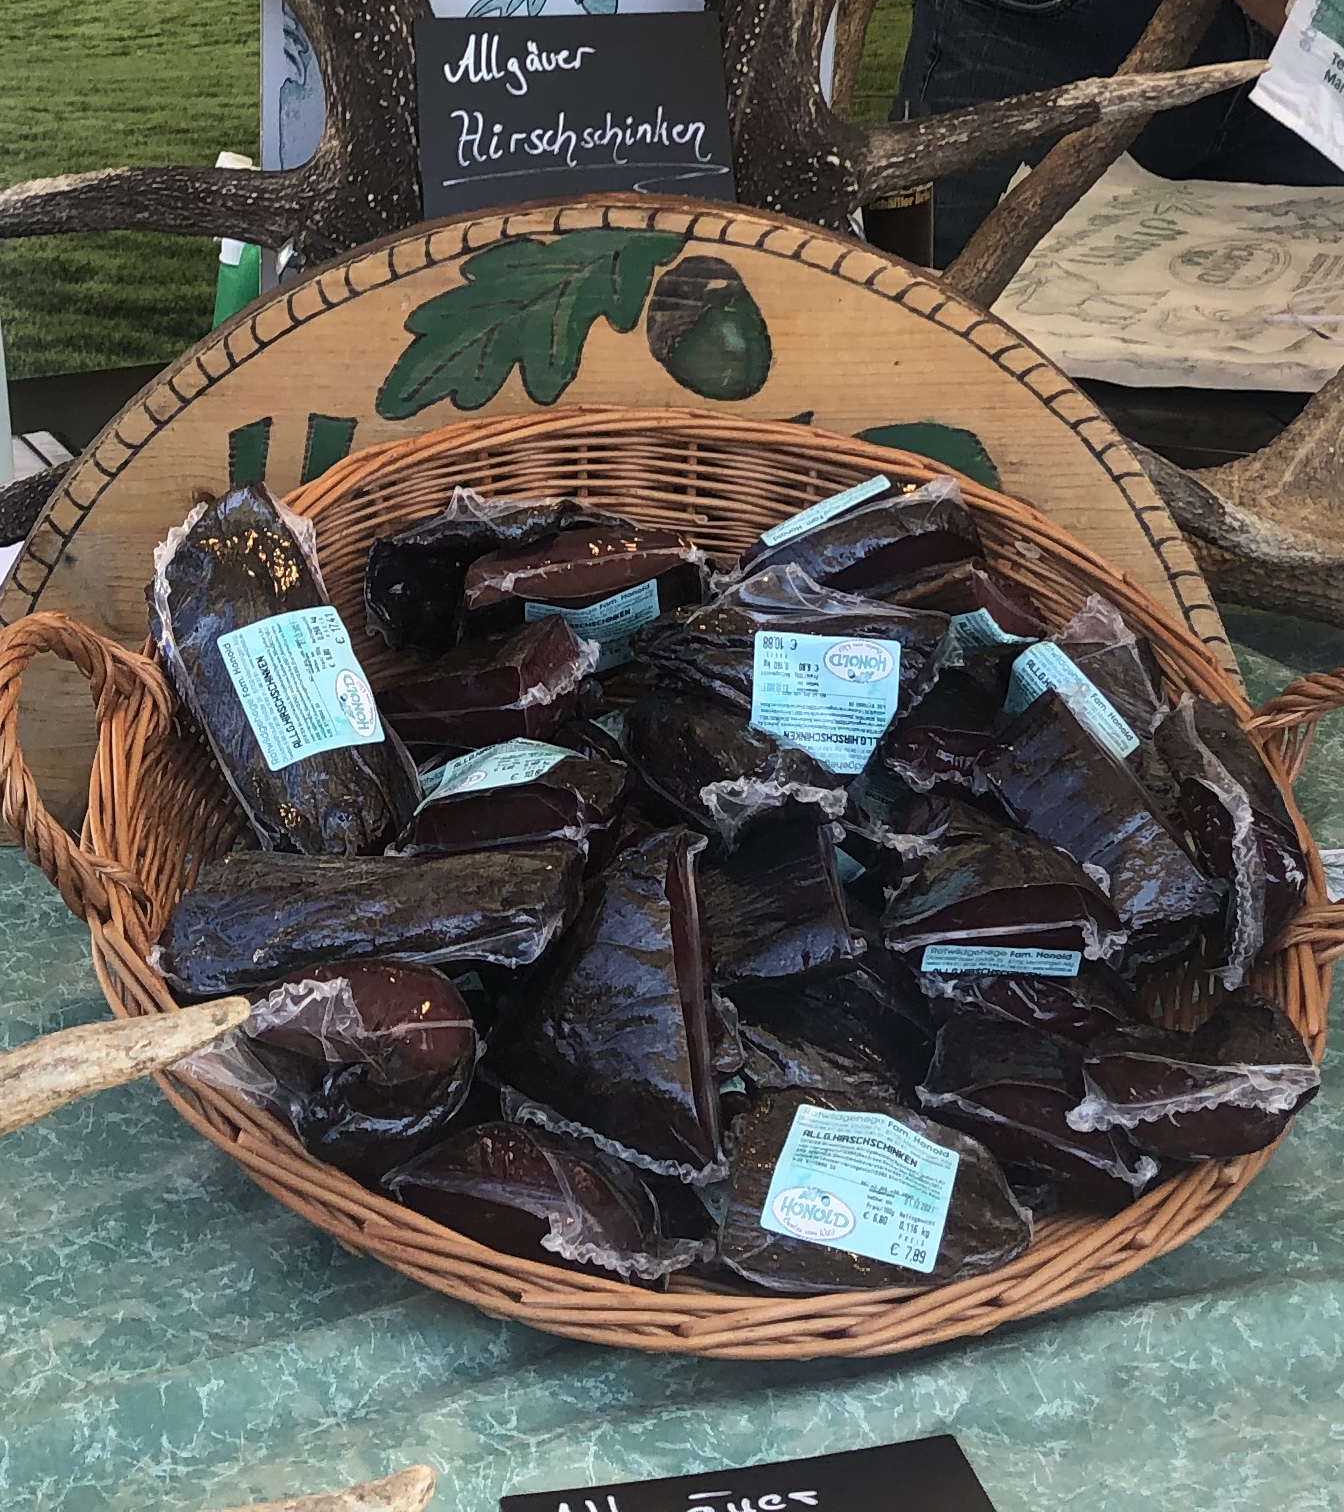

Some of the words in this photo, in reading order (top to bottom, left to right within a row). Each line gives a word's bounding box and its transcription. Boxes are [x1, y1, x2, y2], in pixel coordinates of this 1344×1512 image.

[444, 33, 597, 96] Allgäuer
[449, 105, 713, 168] Hirschschinken
[335, 636, 345, 645] €
[790, 638, 798, 651] €
[223, 642, 242, 676] Honold
[828, 653, 887, 672] HONOLD
[237, 677, 251, 698] Fam.
[343, 674, 370, 731] HONOLD
[246, 697, 280, 766] Rotwildgehege
[1107, 711, 1134, 742] Honold
[930, 947, 1007, 957] Rotwildgehege
[1010, 950, 1033, 958] Fam.
[1036, 951, 1073, 960] Honold
[887, 1120, 909, 1137] Fam.
[913, 1135, 950, 1159] Honold
[781, 1195, 850, 1229] HONOLD
[921, 1226, 931, 1239] kg
[890, 1242, 900, 1256] €
[905, 1245, 927, 1264] 7,89
